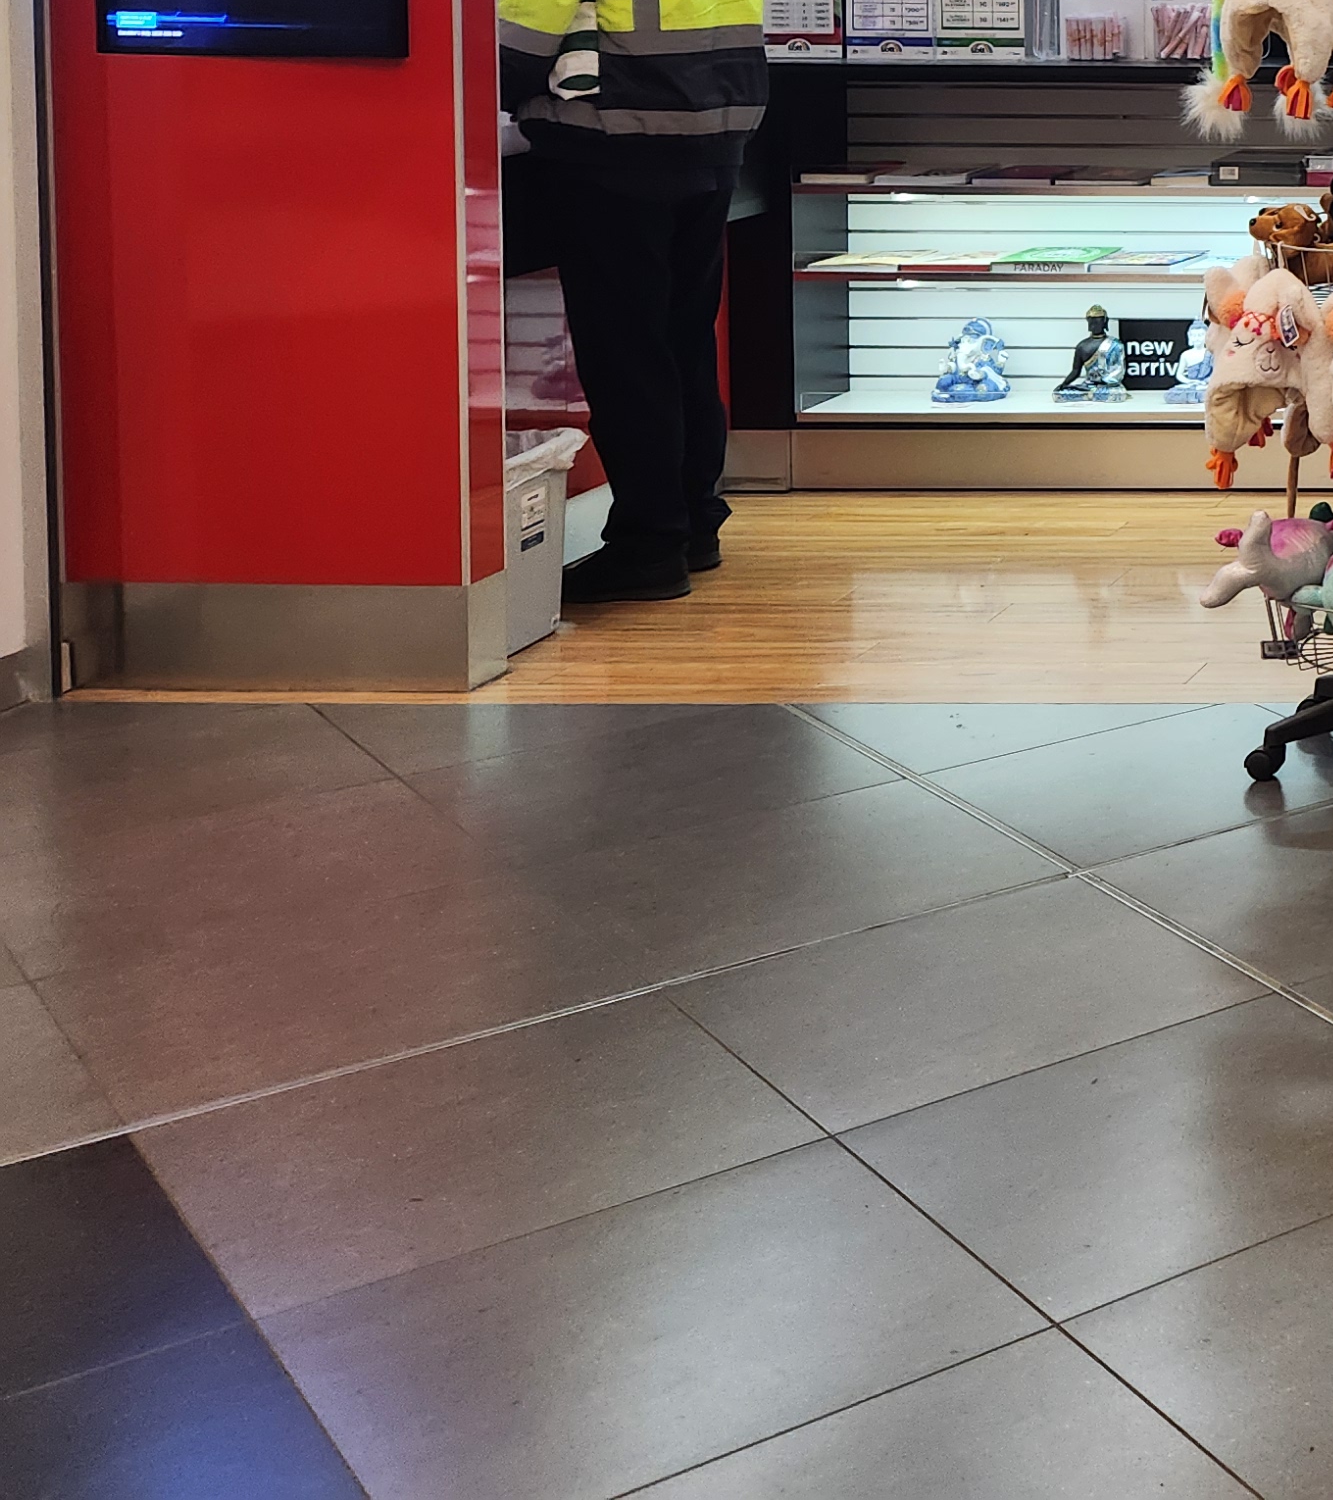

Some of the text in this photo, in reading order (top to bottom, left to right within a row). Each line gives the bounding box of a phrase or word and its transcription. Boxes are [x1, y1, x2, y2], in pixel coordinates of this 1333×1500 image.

[1013, 263, 1064, 273] FARADAY
[1126, 338, 1174, 357] new
[1126, 358, 1179, 378] arriv
